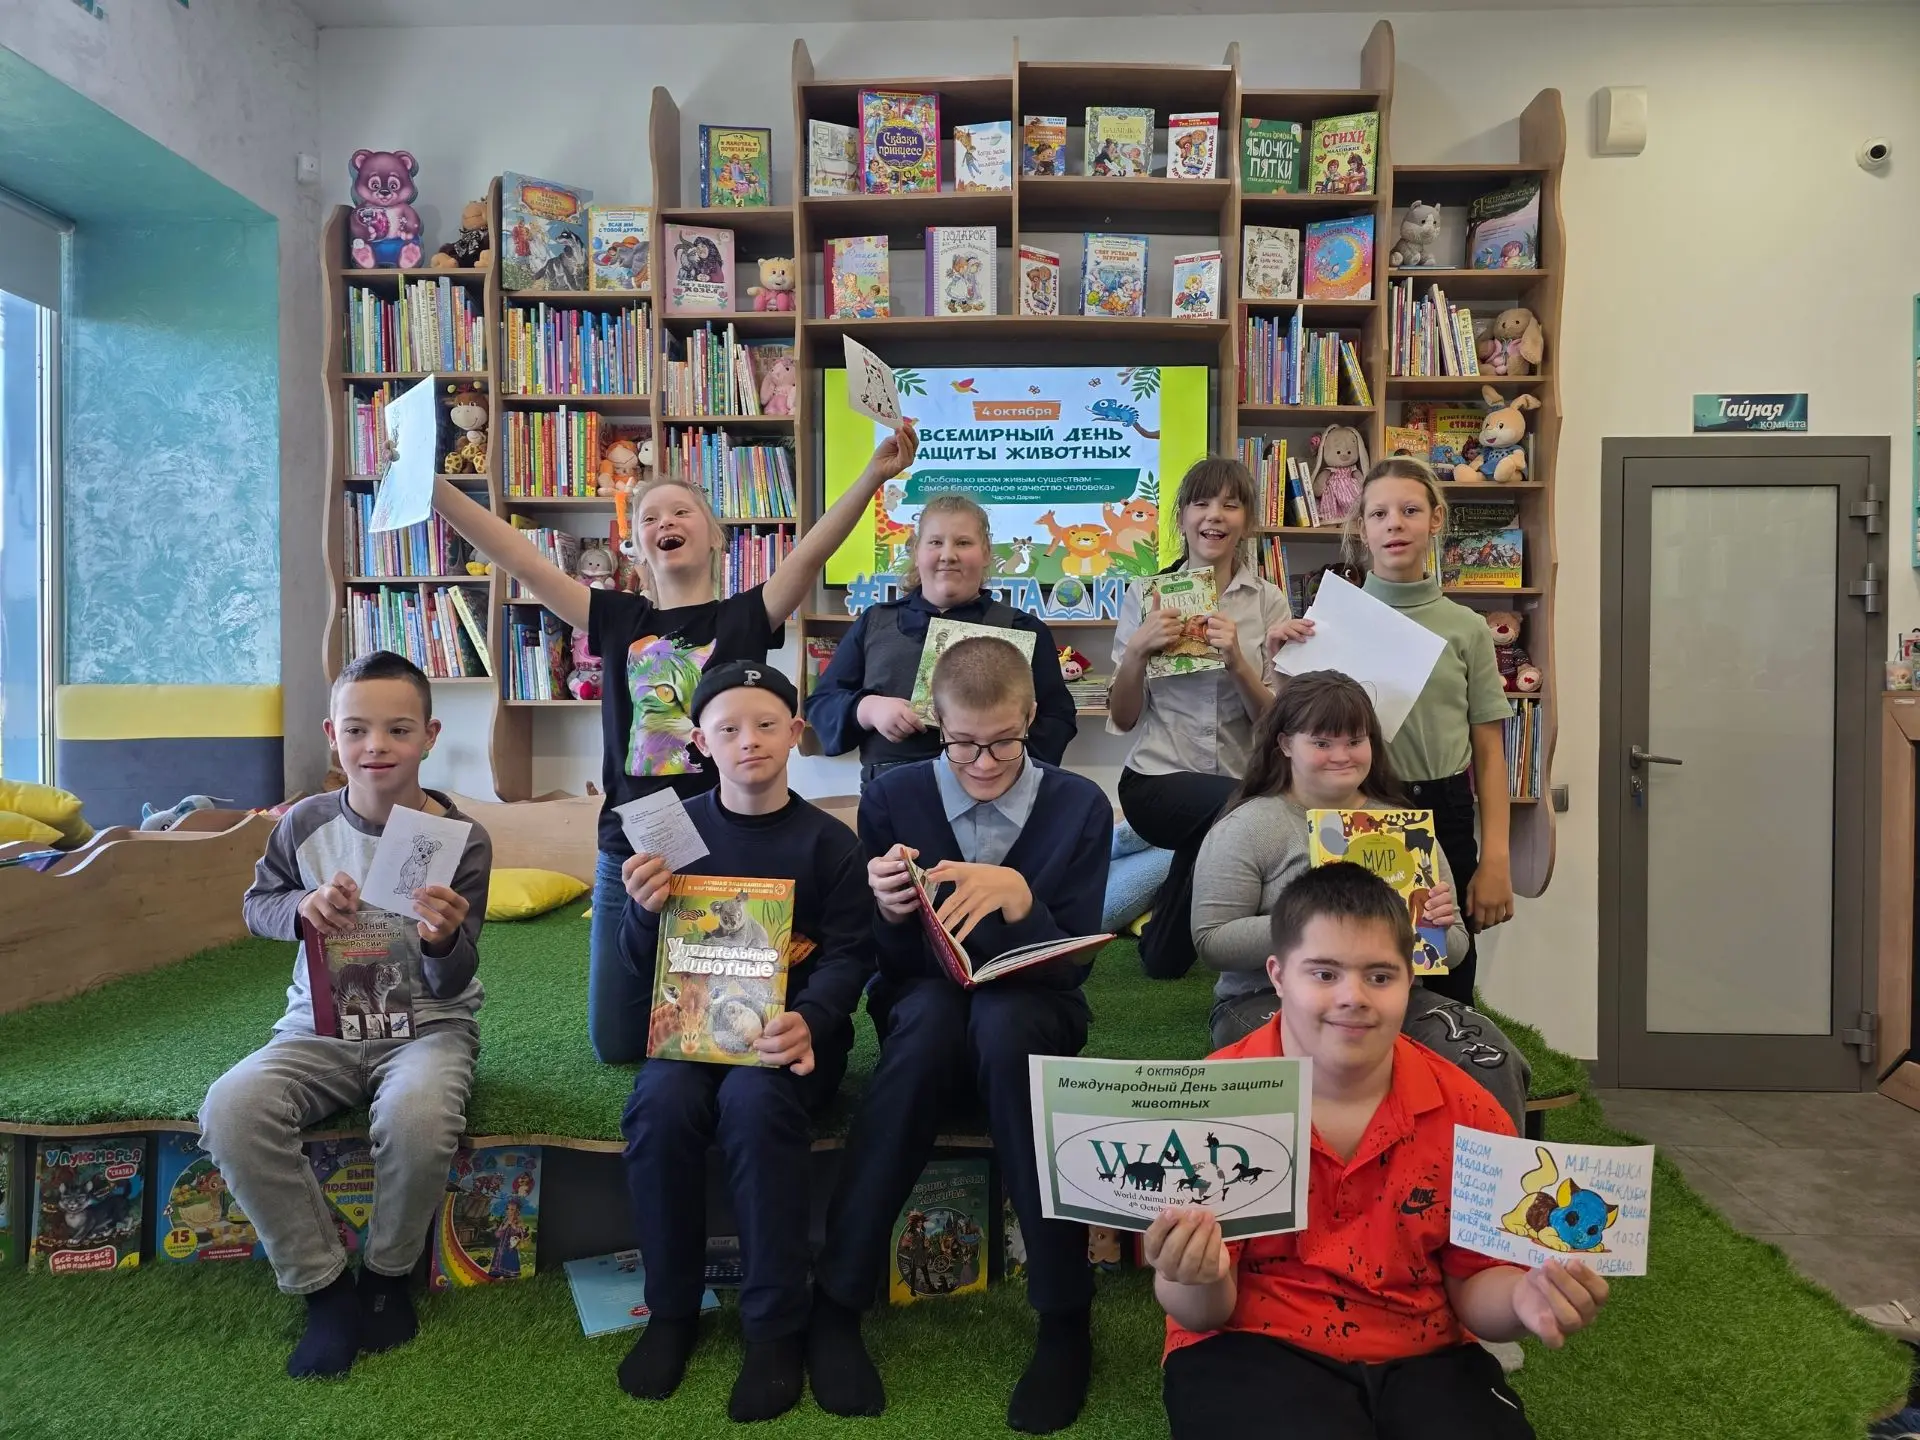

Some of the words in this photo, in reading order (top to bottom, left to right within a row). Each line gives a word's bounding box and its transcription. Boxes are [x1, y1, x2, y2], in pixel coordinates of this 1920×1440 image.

[882, 131, 918, 145] Сказки
[1322, 129, 1367, 149] СТИХИ
[878, 145, 923, 158] принцесс
[1245, 137, 1300, 160] ЯБЛОЧКИ-
[1250, 157, 1293, 180] ПЯТКИ
[942, 229, 987, 243] ПОДАРОК
[981, 406, 991, 417] 4
[993, 406, 1052, 419] октября
[1718, 397, 1785, 421] Тайная
[1760, 419, 1807, 430] комната
[919, 425, 1055, 443] ВСЕМИРНЫЙ
[1062, 427, 1124, 443] ДЕНЬ
[914, 446, 997, 461] АЩИТЫ
[1005, 444, 1132, 460] ЖИВОТНЫХ
[951, 484, 1015, 493] благородное
[1037, 477, 1092, 485] существам
[743, 669, 762, 686] P
[1362, 848, 1396, 872] МИР
[340, 932, 376, 941] Красной
[377, 931, 401, 939] книги
[350, 940, 382, 948] России
[1134, 1065, 1143, 1077] 4
[1146, 1065, 1206, 1079] октября
[1057, 1077, 1178, 1094] Международный
[1180, 1080, 1219, 1095] День
[1221, 1078, 1284, 1093] защиты
[1131, 1099, 1211, 1110] животных
[46, 1149, 60, 1167] У
[1088, 1128, 1250, 1187] WAD
[1113, 1190, 1137, 1201] World
[1138, 1193, 1168, 1205] Animal
[1168, 1196, 1186, 1207] Day
[1139, 1202, 1168, 1213] Octob
[171, 1229, 190, 1244] 15
